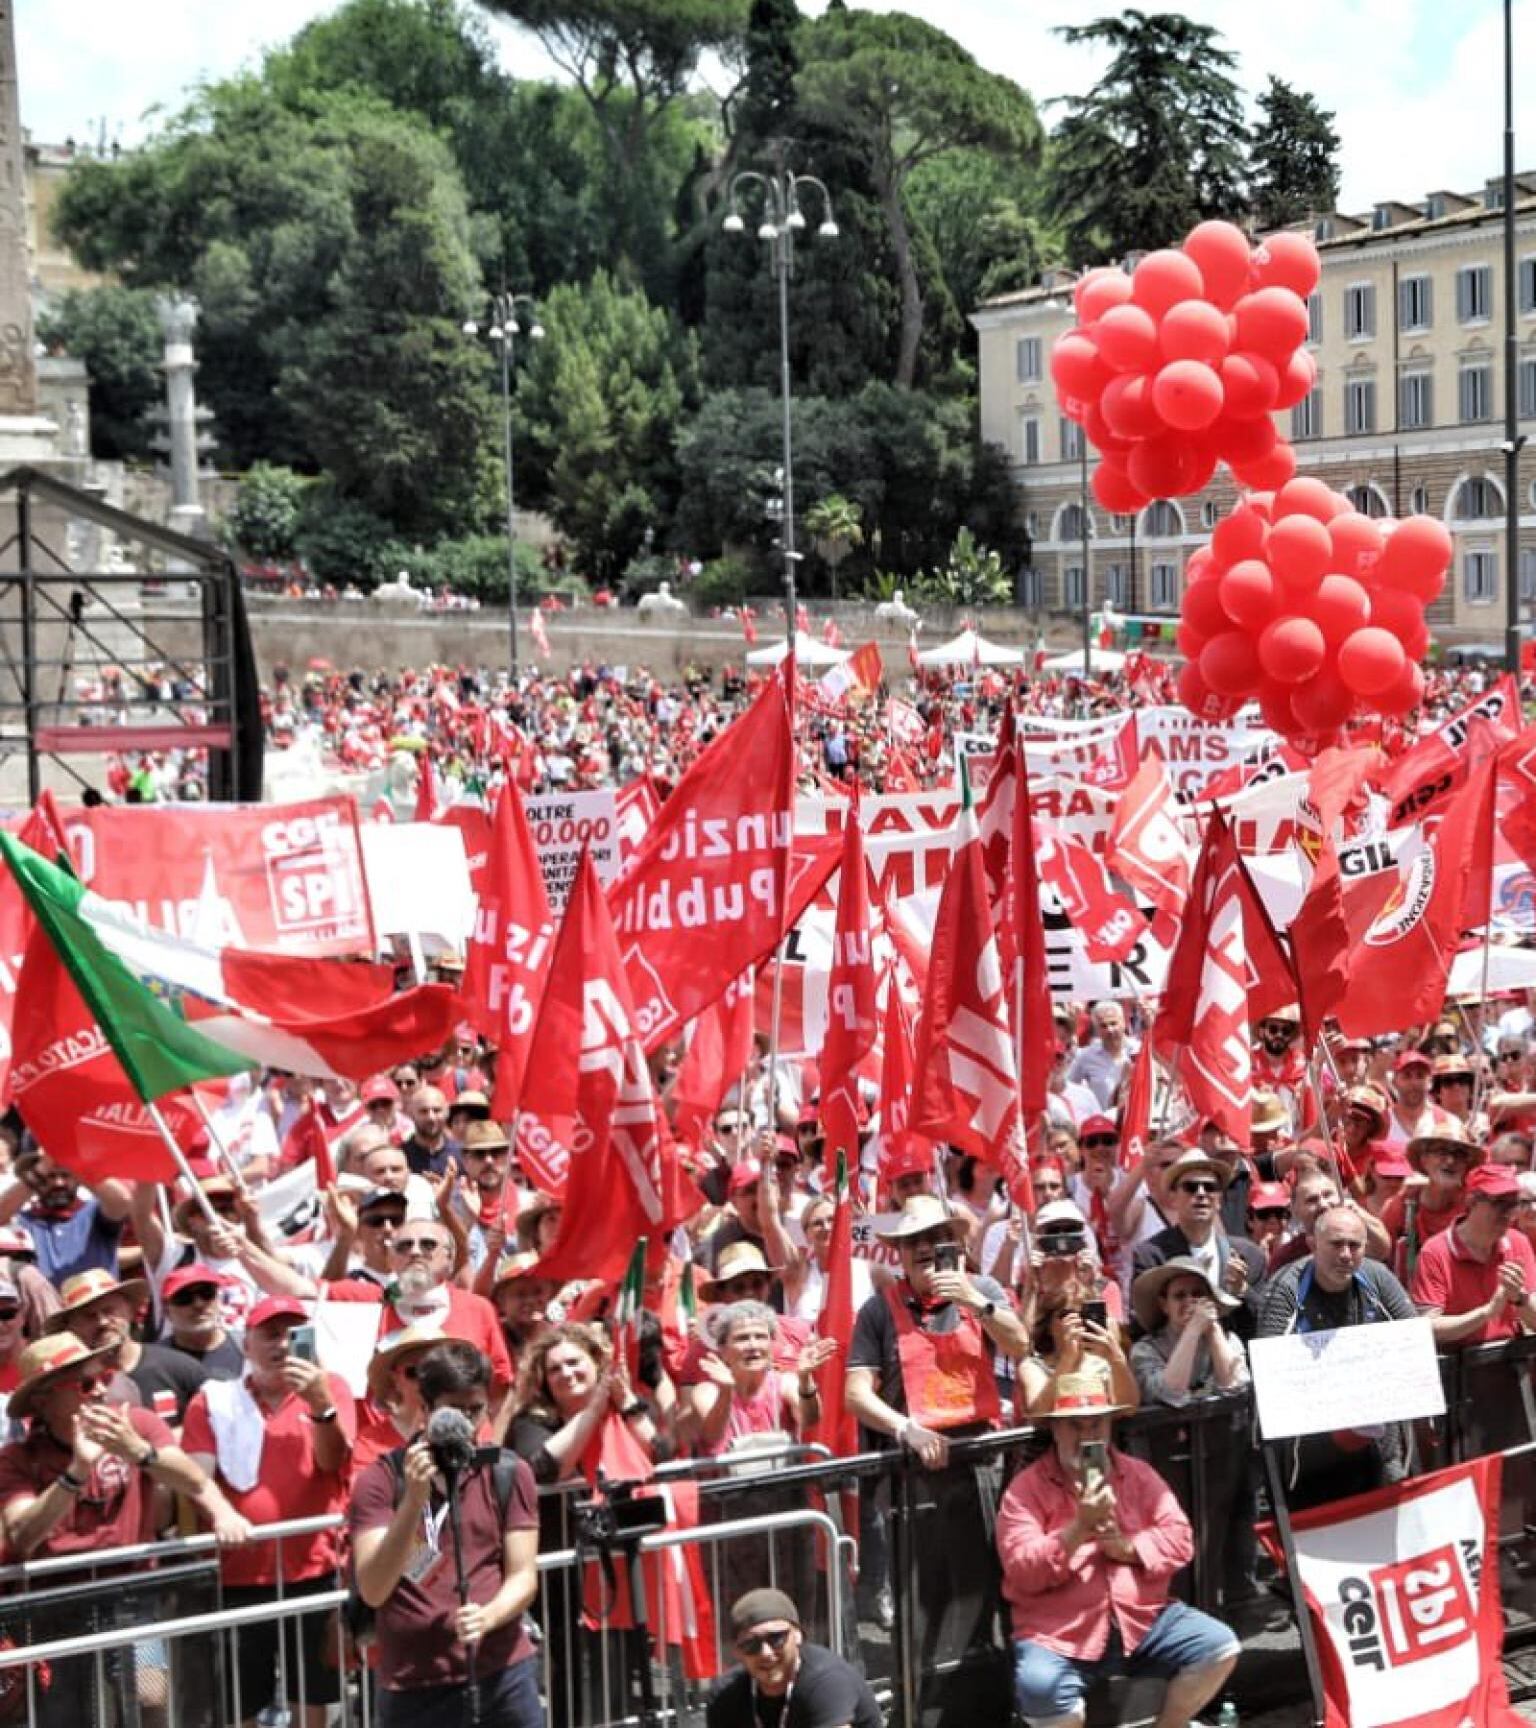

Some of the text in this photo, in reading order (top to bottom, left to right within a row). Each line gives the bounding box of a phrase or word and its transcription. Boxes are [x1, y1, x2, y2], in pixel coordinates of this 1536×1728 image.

[526, 803, 575, 820] OLTRE
[529, 817, 609, 845] 0.000
[1338, 842, 1398, 876] GIL
[281, 872, 354, 920] SPI
